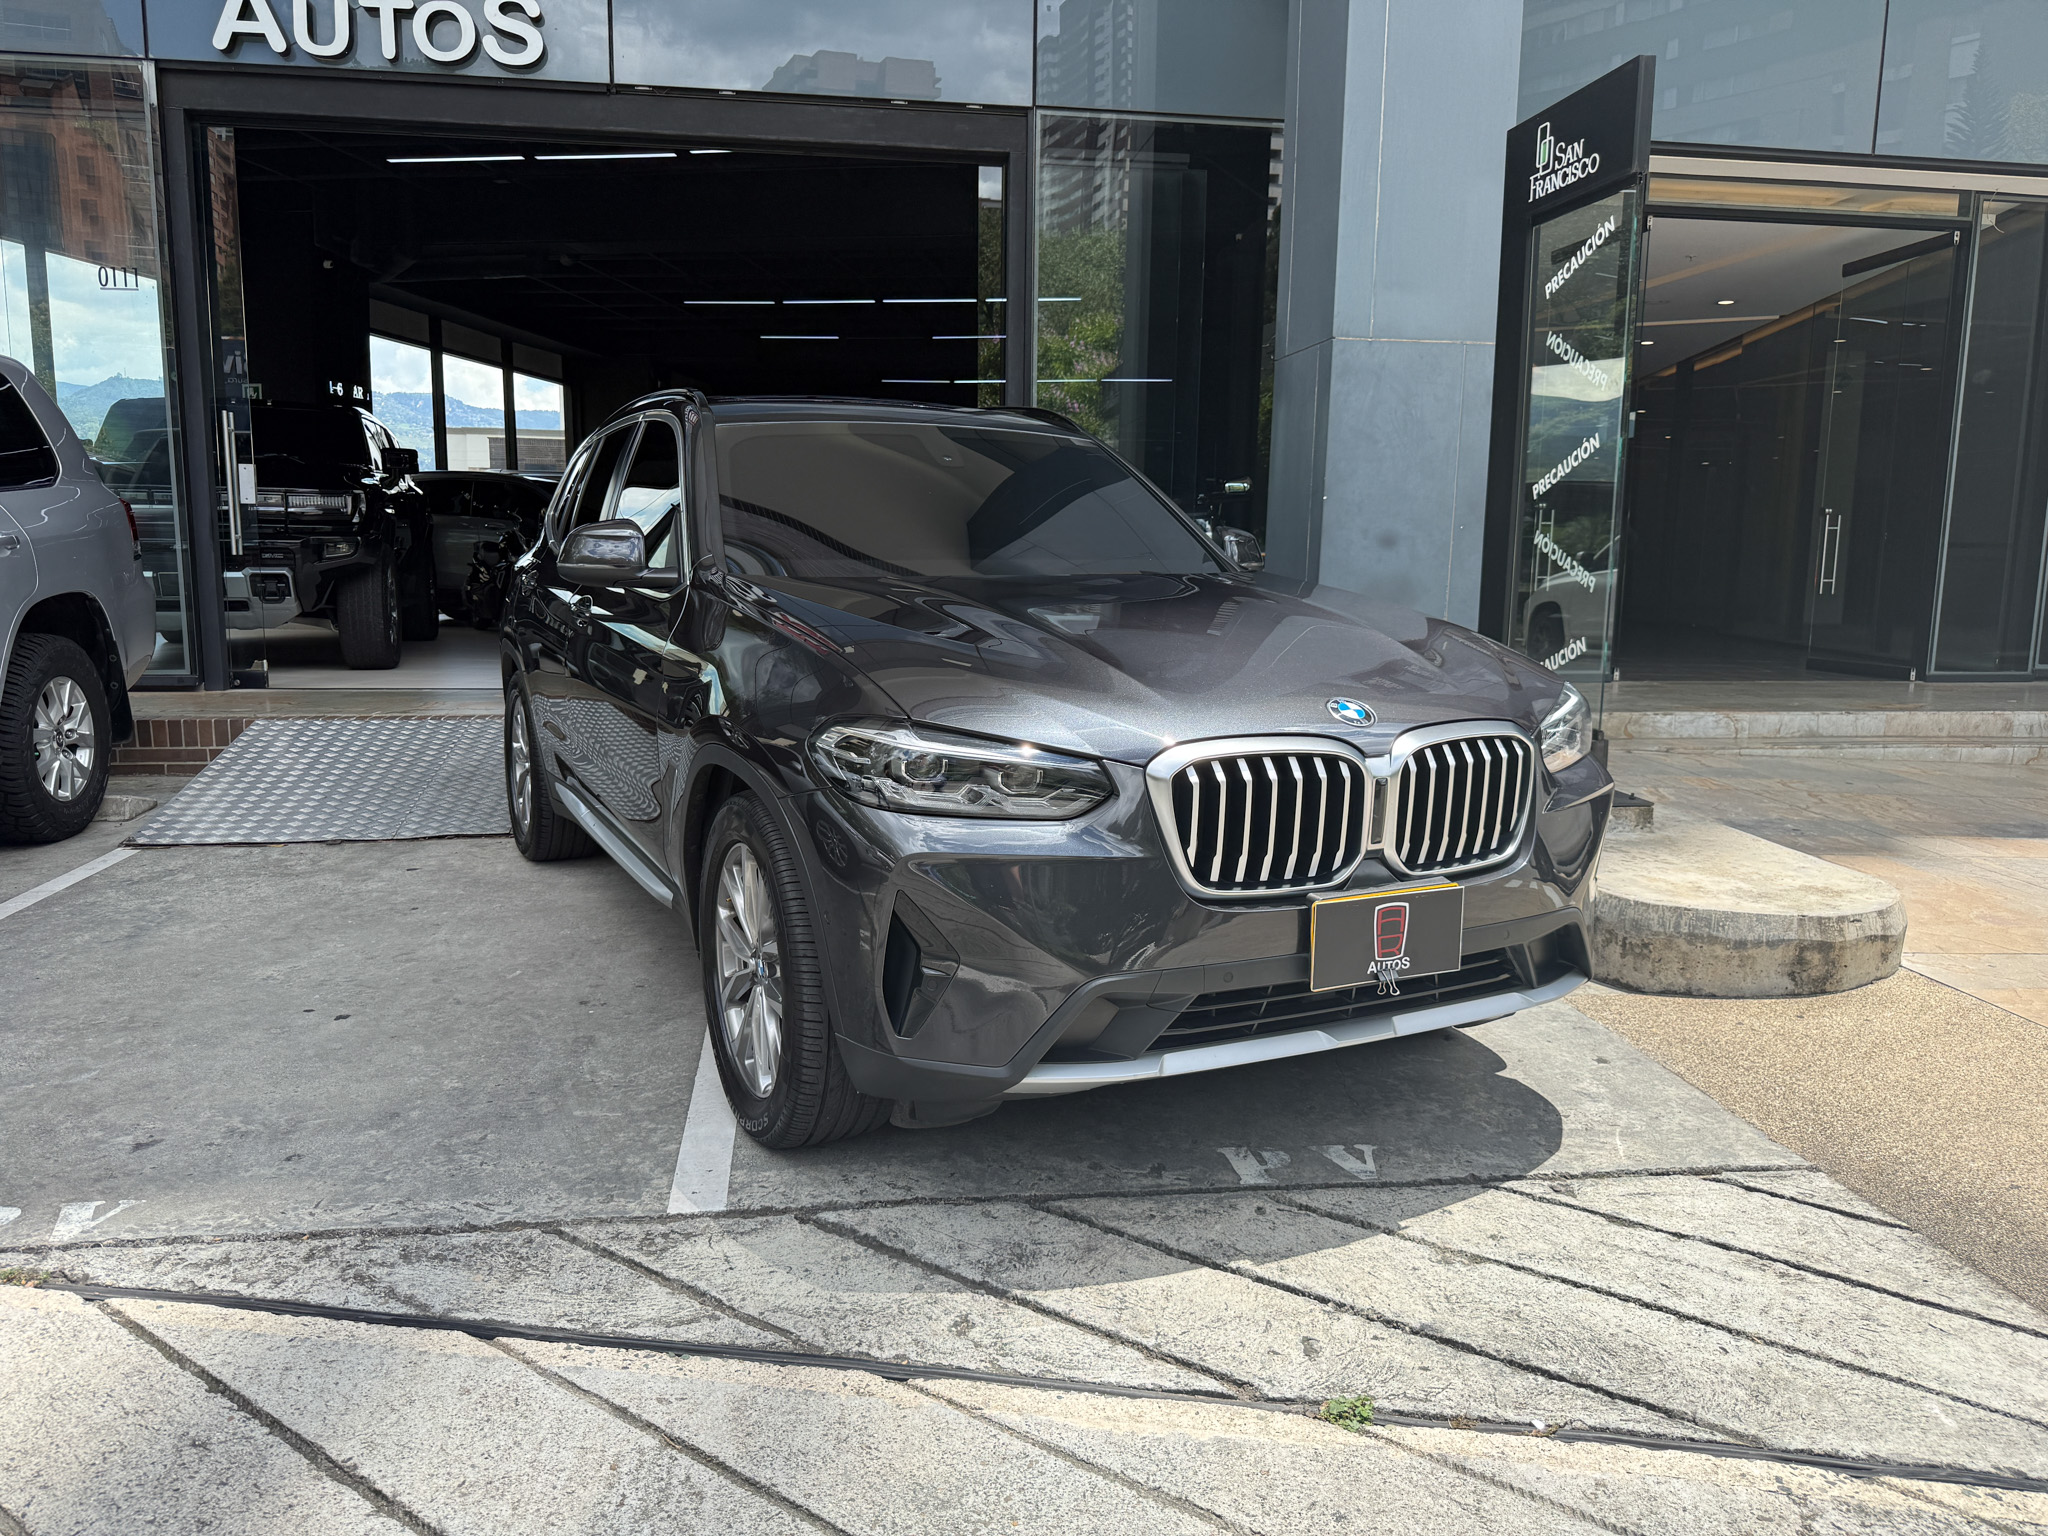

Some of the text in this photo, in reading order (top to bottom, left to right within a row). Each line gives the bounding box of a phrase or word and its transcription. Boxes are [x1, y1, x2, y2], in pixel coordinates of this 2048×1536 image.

[212, 0, 544, 66] AUTOS
[1528, 153, 1600, 203] FRANCISCO
[1554, 138, 1585, 170] SAN
[1545, 215, 1615, 300] PRECAUCIÓN
[1532, 432, 1600, 500] PRECAUCIÓN
[1539, 636, 1587, 671] AUCIÓN
[1366, 956, 1411, 974] AUTOS
